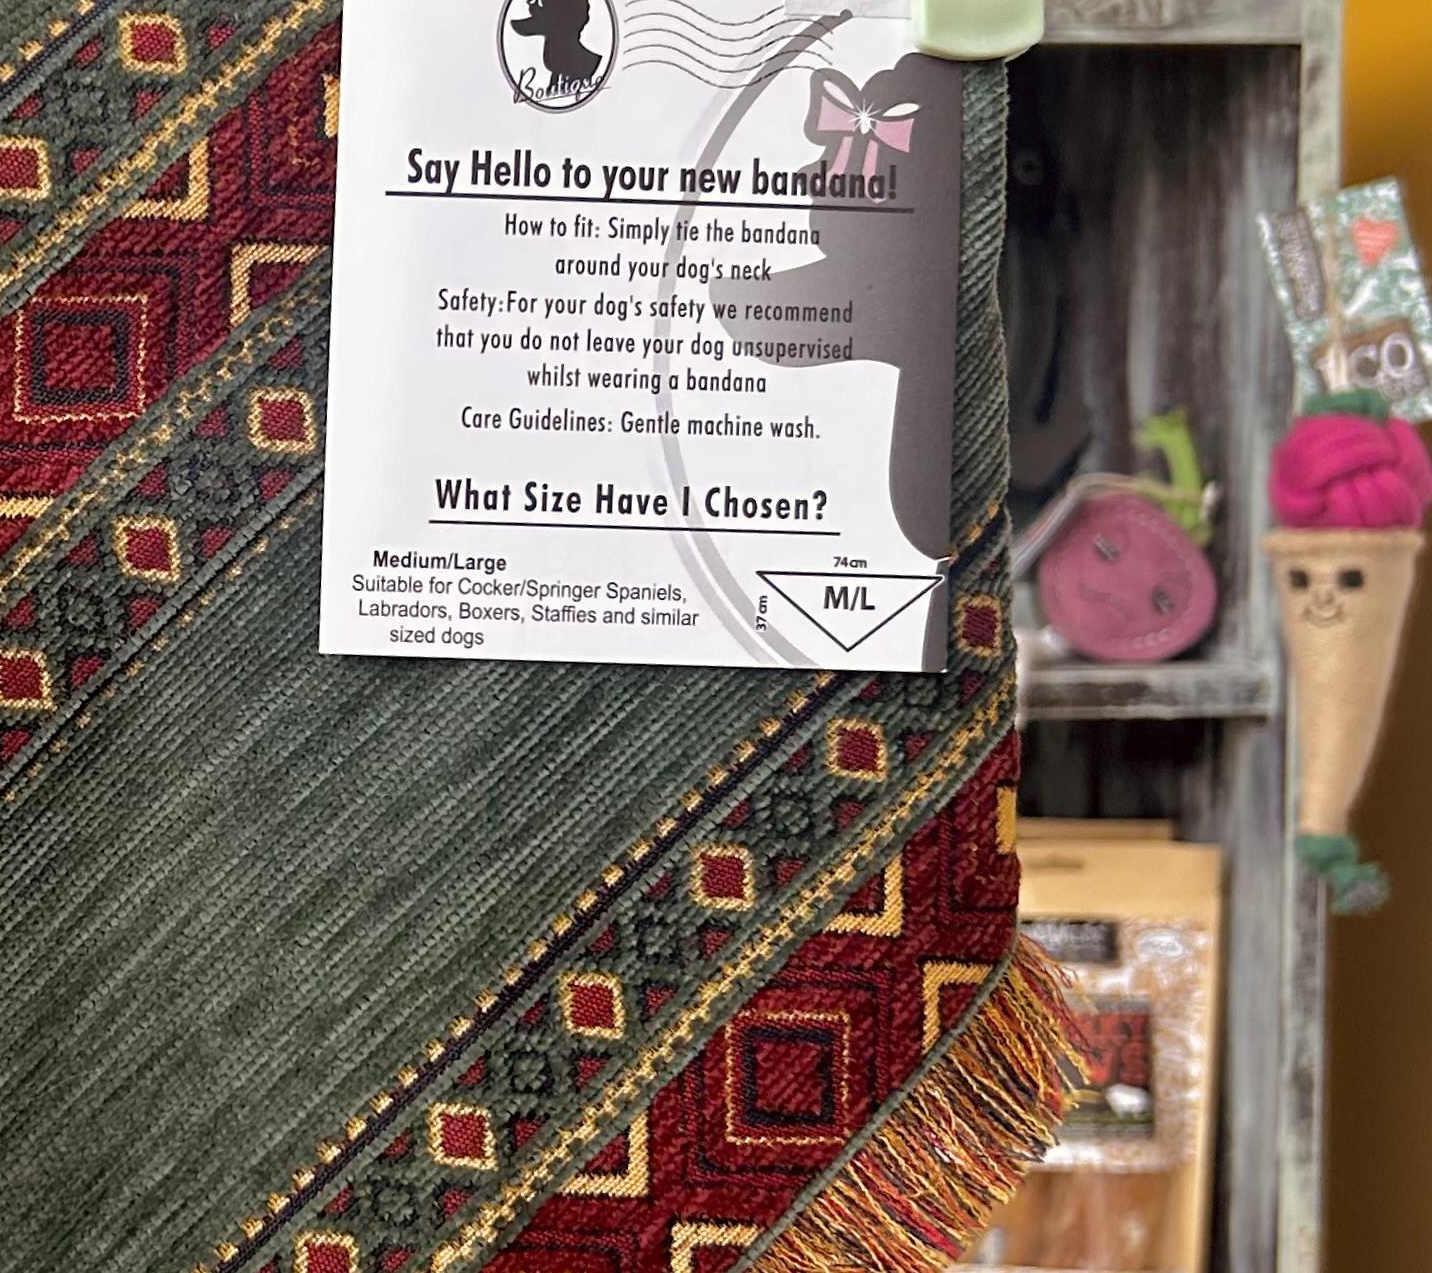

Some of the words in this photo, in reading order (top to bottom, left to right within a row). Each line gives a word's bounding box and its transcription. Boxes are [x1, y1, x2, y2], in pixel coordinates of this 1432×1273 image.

[513, 67, 610, 104] Boutique
[407, 148, 460, 194] Say
[471, 150, 550, 188] Hello
[562, 158, 591, 189] to
[602, 163, 669, 199] your
[680, 167, 741, 195] new
[752, 159, 899, 201] bandana!
[505, 213, 542, 237] How
[550, 216, 567, 237] to
[573, 214, 600, 239] fit:
[608, 216, 671, 246] Simply
[676, 219, 700, 242] tie
[705, 220, 734, 244] the
[741, 221, 820, 246] bandana
[555, 253, 620, 277] around
[628, 260, 669, 283] your
[676, 256, 723, 284] dog's
[730, 258, 771, 282] neck
[544, 295, 587, 319] your
[594, 294, 643, 322] dog's
[649, 295, 705, 322] safety
[713, 304, 738, 321] we
[745, 300, 853, 324] recommend
[436, 325, 474, 349] that
[481, 331, 512, 354] you
[520, 327, 542, 351] do
[550, 330, 579, 352] not
[587, 329, 635, 354] leave
[642, 336, 684, 359] your
[691, 333, 725, 360] dog
[732, 338, 853, 363] unsupervised
[527, 364, 582, 388] whilst
[588, 369, 661, 395] wearing
[668, 374, 679, 392] a
[687, 368, 767, 393] bandana
[461, 407, 502, 430] Care
[509, 408, 613, 433] Guidelines:
[621, 411, 680, 435] Gentle
[687, 414, 763, 437] machine
[770, 416, 821, 439] wash.
[435, 478, 511, 511] What
[524, 481, 582, 513] Size
[595, 484, 668, 516] Have
[682, 486, 690, 516] I
[705, 486, 827, 520] Chosen?
[373, 550, 507, 574] Medium/Large
[352, 574, 424, 594] Suitable
[428, 576, 452, 594] for
[457, 577, 601, 603] Cocker/Springer
[606, 582, 686, 604] Spaniels,
[823, 586, 875, 611] M/L
[358, 598, 452, 621] Labradors,
[459, 602, 525, 624] Boxers,
[531, 604, 597, 624] Staffies
[602, 607, 635, 624] and
[640, 607, 699, 627] similar
[389, 626, 435, 644] sized
[441, 627, 485, 648] dogs
